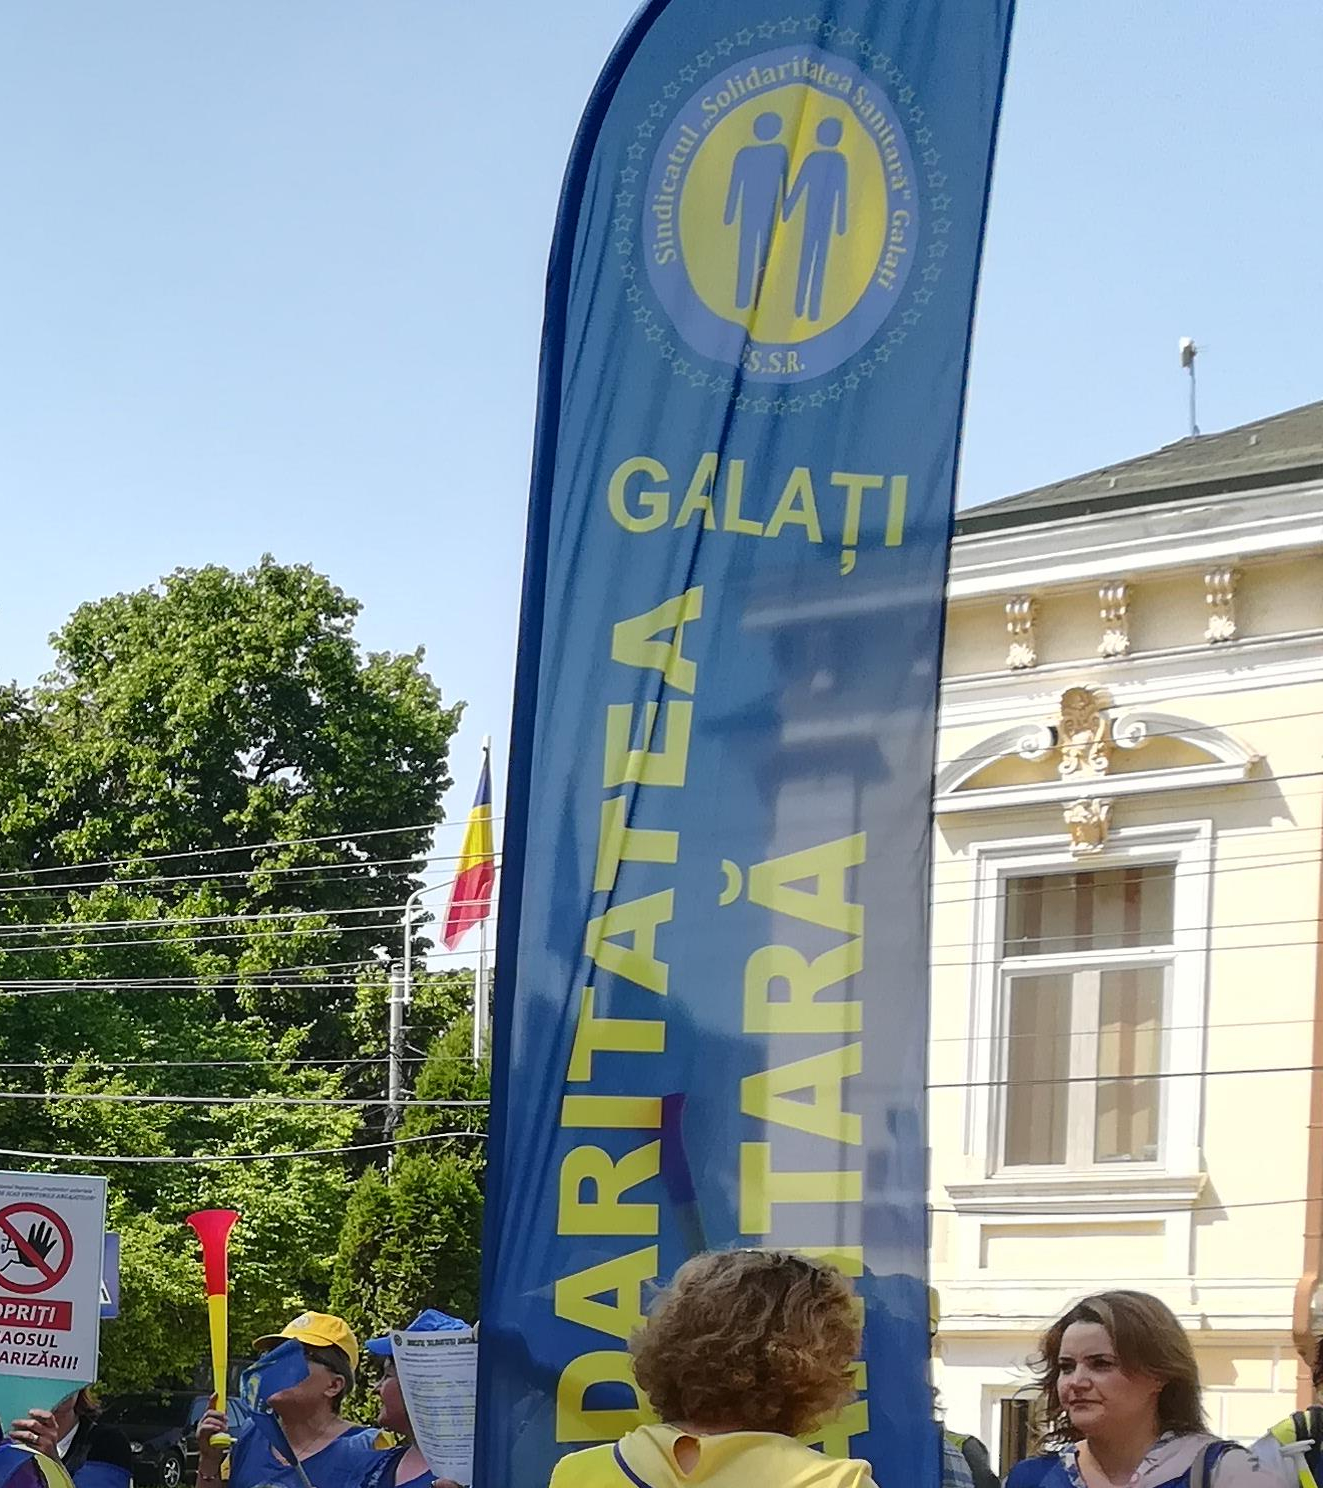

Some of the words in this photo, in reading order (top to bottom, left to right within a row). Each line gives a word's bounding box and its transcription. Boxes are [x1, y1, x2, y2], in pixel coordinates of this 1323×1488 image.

[652, 125, 700, 266] Sindicatul
[608, 451, 909, 577] GALAȚI
[554, 584, 705, 1444] DARITATEA
